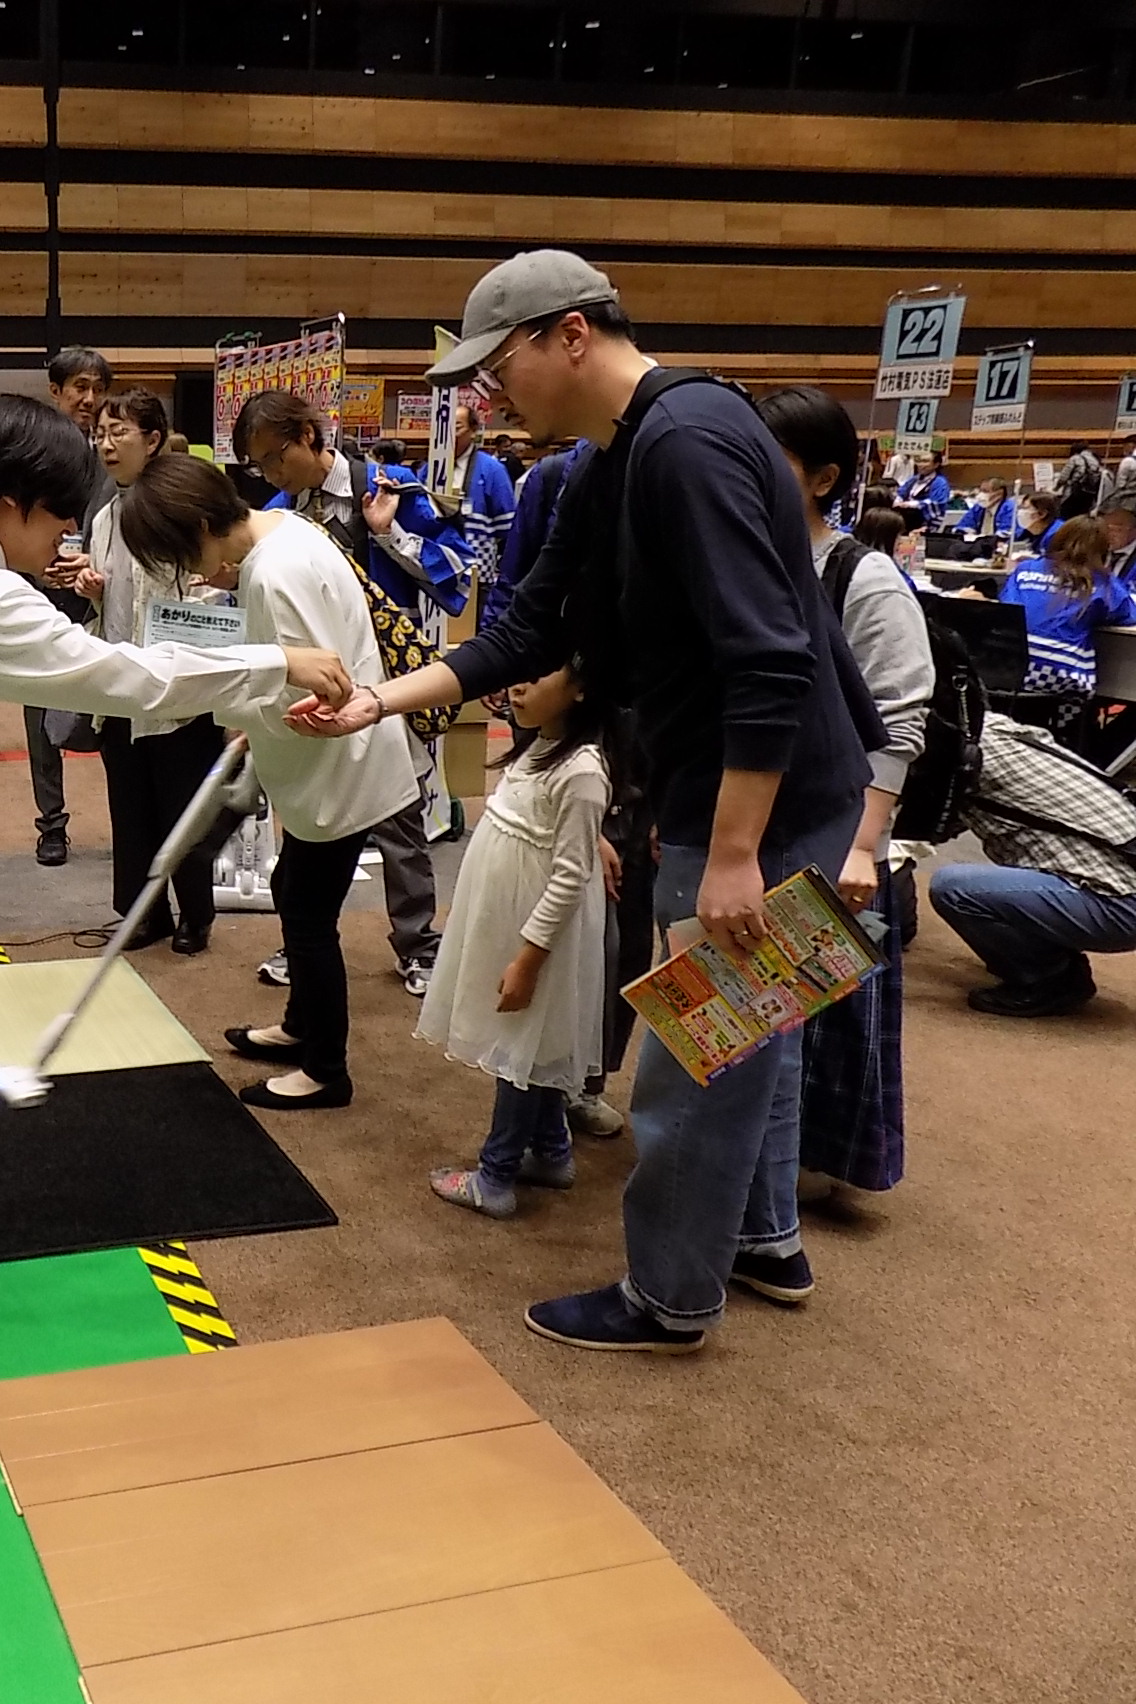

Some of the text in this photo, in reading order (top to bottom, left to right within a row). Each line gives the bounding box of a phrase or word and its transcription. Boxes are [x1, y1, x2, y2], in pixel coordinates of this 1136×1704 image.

[898, 307, 945, 356] 22
[988, 361, 1020, 398] 17
[907, 403, 929, 431] 13
